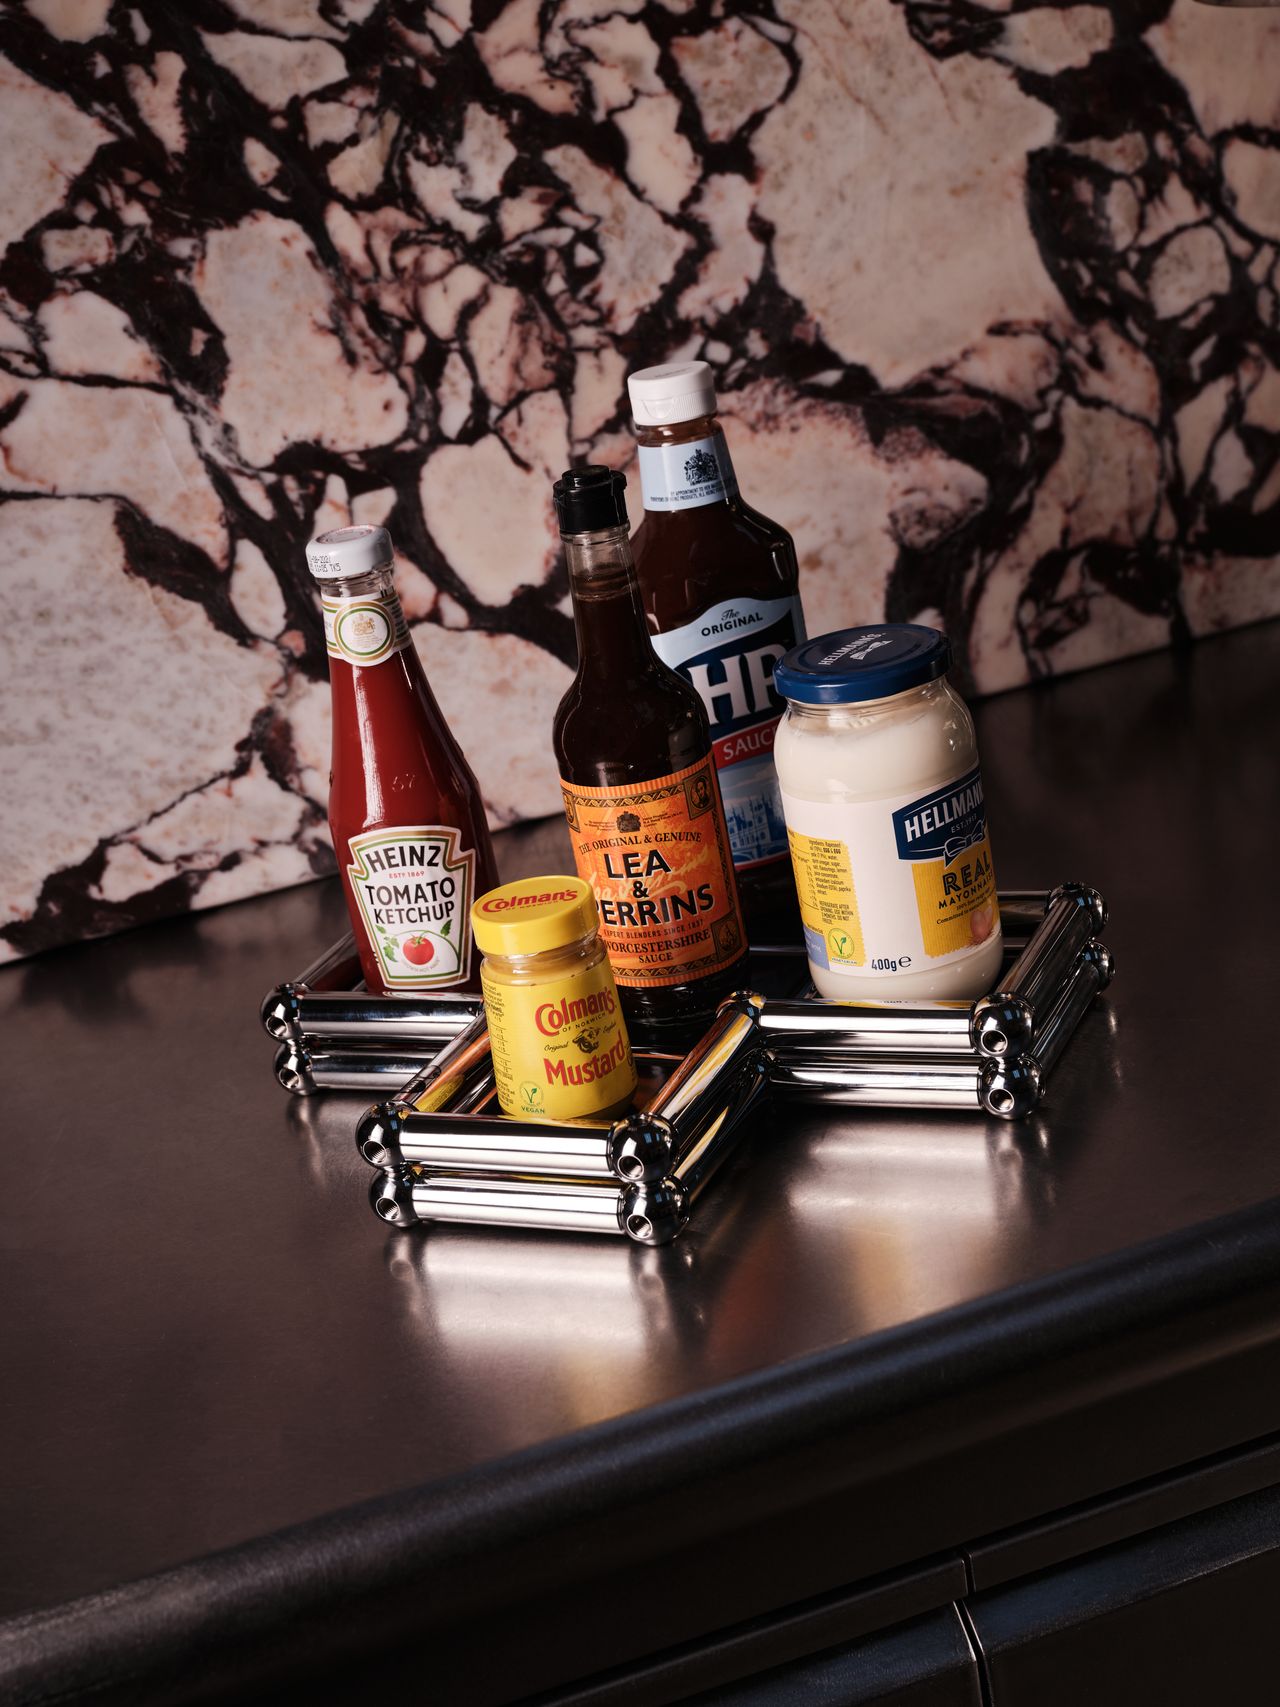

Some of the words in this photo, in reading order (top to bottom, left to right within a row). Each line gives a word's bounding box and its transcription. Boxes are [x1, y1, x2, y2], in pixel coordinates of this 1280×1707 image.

[701, 612, 763, 637] ORIGINAL
[720, 608, 741, 621] The
[687, 643, 787, 726] HP
[723, 727, 776, 760] SAUC
[579, 840, 590, 855] THE
[592, 835, 642, 850] ORIGINAL
[644, 834, 653, 844] &
[655, 832, 702, 843] GENUINE
[365, 845, 442, 873] HEINZ
[604, 849, 671, 880] LEA
[407, 870, 425, 878] 1869
[942, 850, 991, 896] REAL
[365, 877, 456, 906] TOMATO
[482, 889, 578, 914] Colman's
[633, 881, 649, 898] &
[373, 900, 455, 925] KETCHUP
[596, 883, 714, 928] ERRINS
[625, 929, 661, 939] BLENDERS
[664, 926, 685, 936] SINCE
[638, 952, 674, 964] SAUCE
[871, 957, 897, 972] 400g
[535, 988, 617, 1037] Colman's
[575, 1012, 606, 1029] NORWICH
[543, 1028, 626, 1087] Mustard
[521, 1105, 546, 1115] VEGAN
